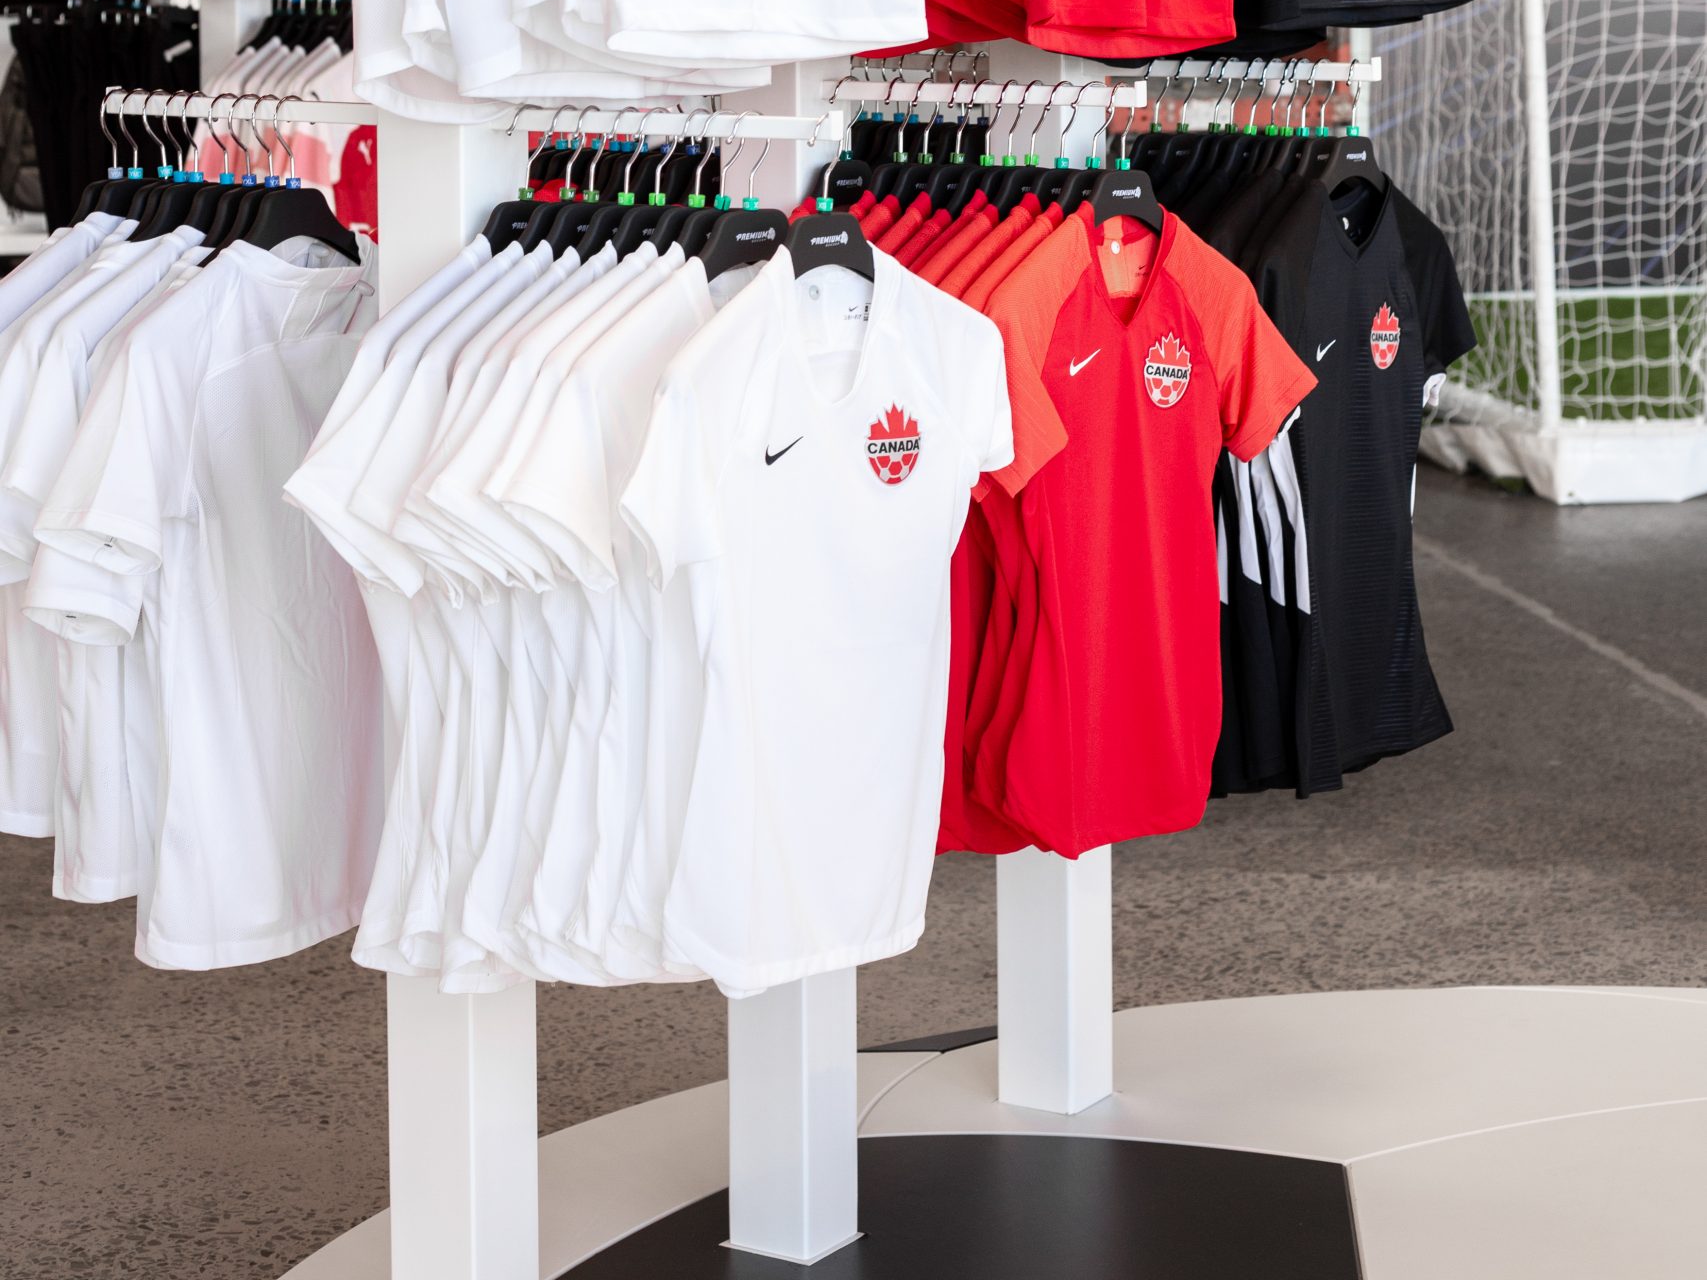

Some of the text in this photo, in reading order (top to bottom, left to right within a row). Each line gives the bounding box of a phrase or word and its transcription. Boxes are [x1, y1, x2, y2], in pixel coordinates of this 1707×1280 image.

[736, 230, 768, 241] PREMIUM
[810, 234, 841, 246] PREMIUM
[1146, 365, 1188, 380] CANADA
[867, 439, 920, 454] CANADA
